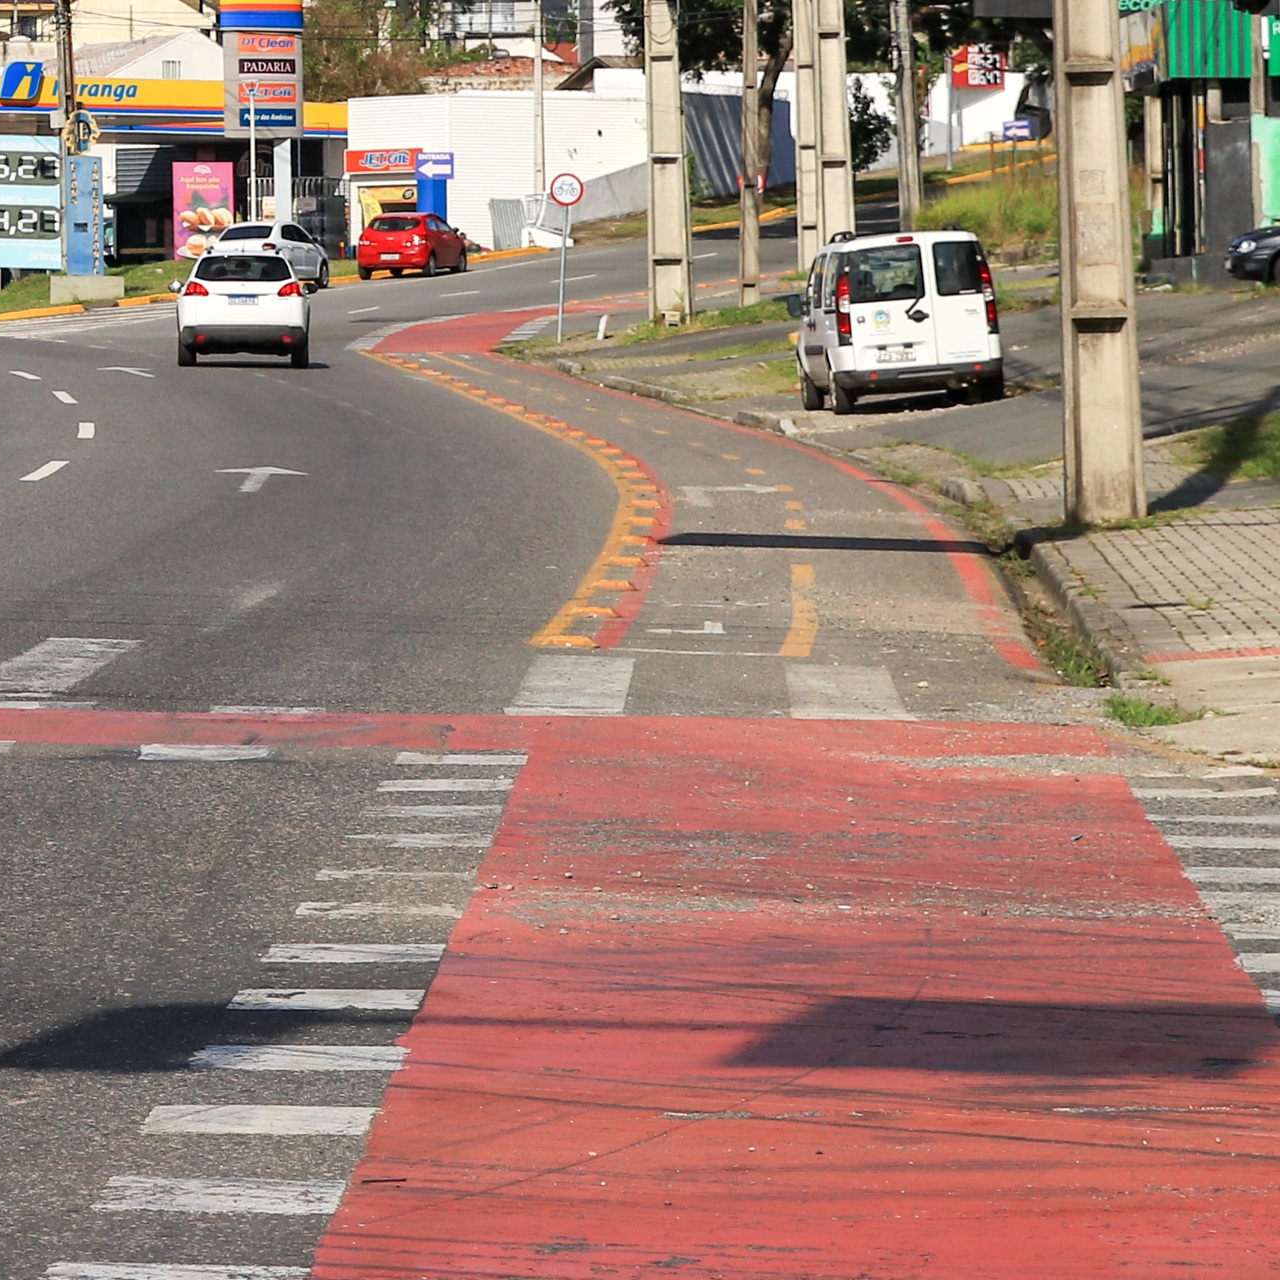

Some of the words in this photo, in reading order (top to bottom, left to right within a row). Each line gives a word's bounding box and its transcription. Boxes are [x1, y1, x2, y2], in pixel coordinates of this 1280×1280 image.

[258, 37, 294, 48] Clean
[243, 61, 292, 72] PADARIA
[360, 152, 387, 166] JET
[417, 153, 451, 161] ENTRADA
[70, 161, 79, 205] LIONS
[179, 176, 195, 184] Aqui
[208, 176, 221, 184] pão
[91, 161, 101, 275] INTERNACIONAL
